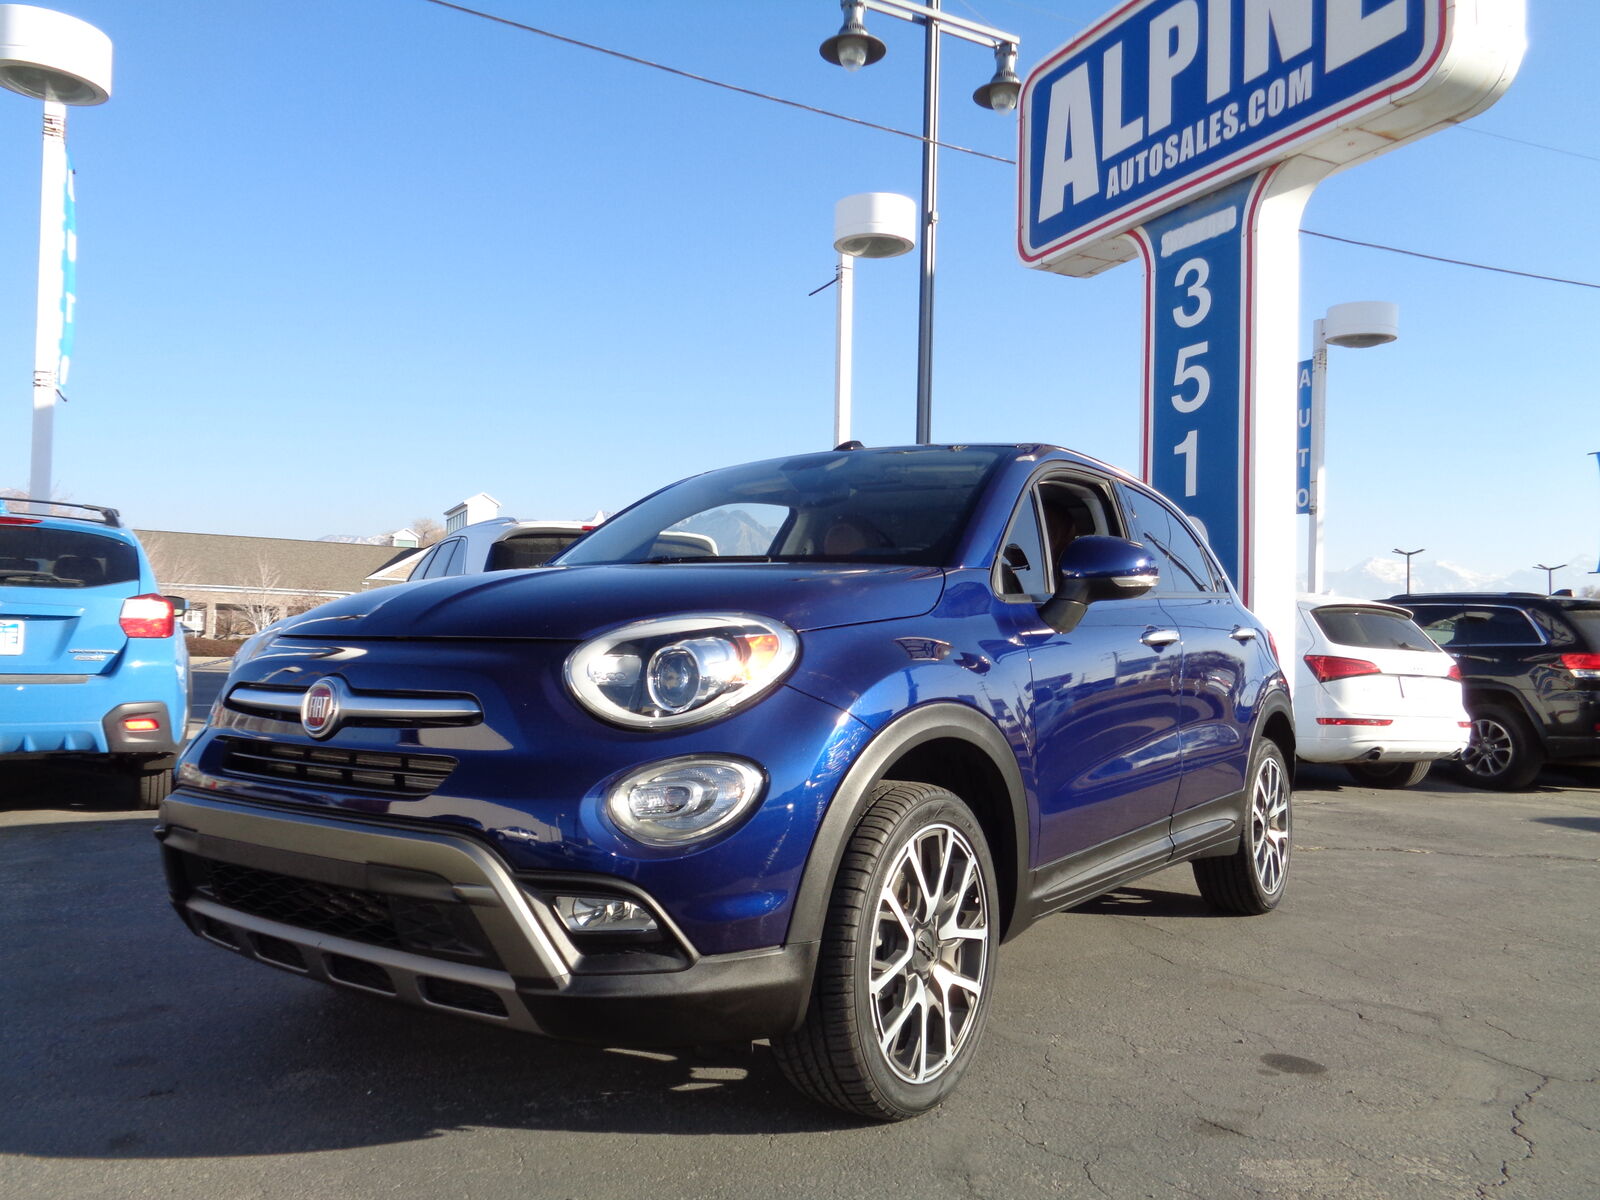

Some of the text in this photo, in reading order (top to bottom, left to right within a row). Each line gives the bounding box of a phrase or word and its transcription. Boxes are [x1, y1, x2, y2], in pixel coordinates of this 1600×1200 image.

[1106, 62, 1313, 200] AUTOSALES.COM
[1296, 368, 1311, 507] AUTO
[309, 696, 330, 718] FIAT
